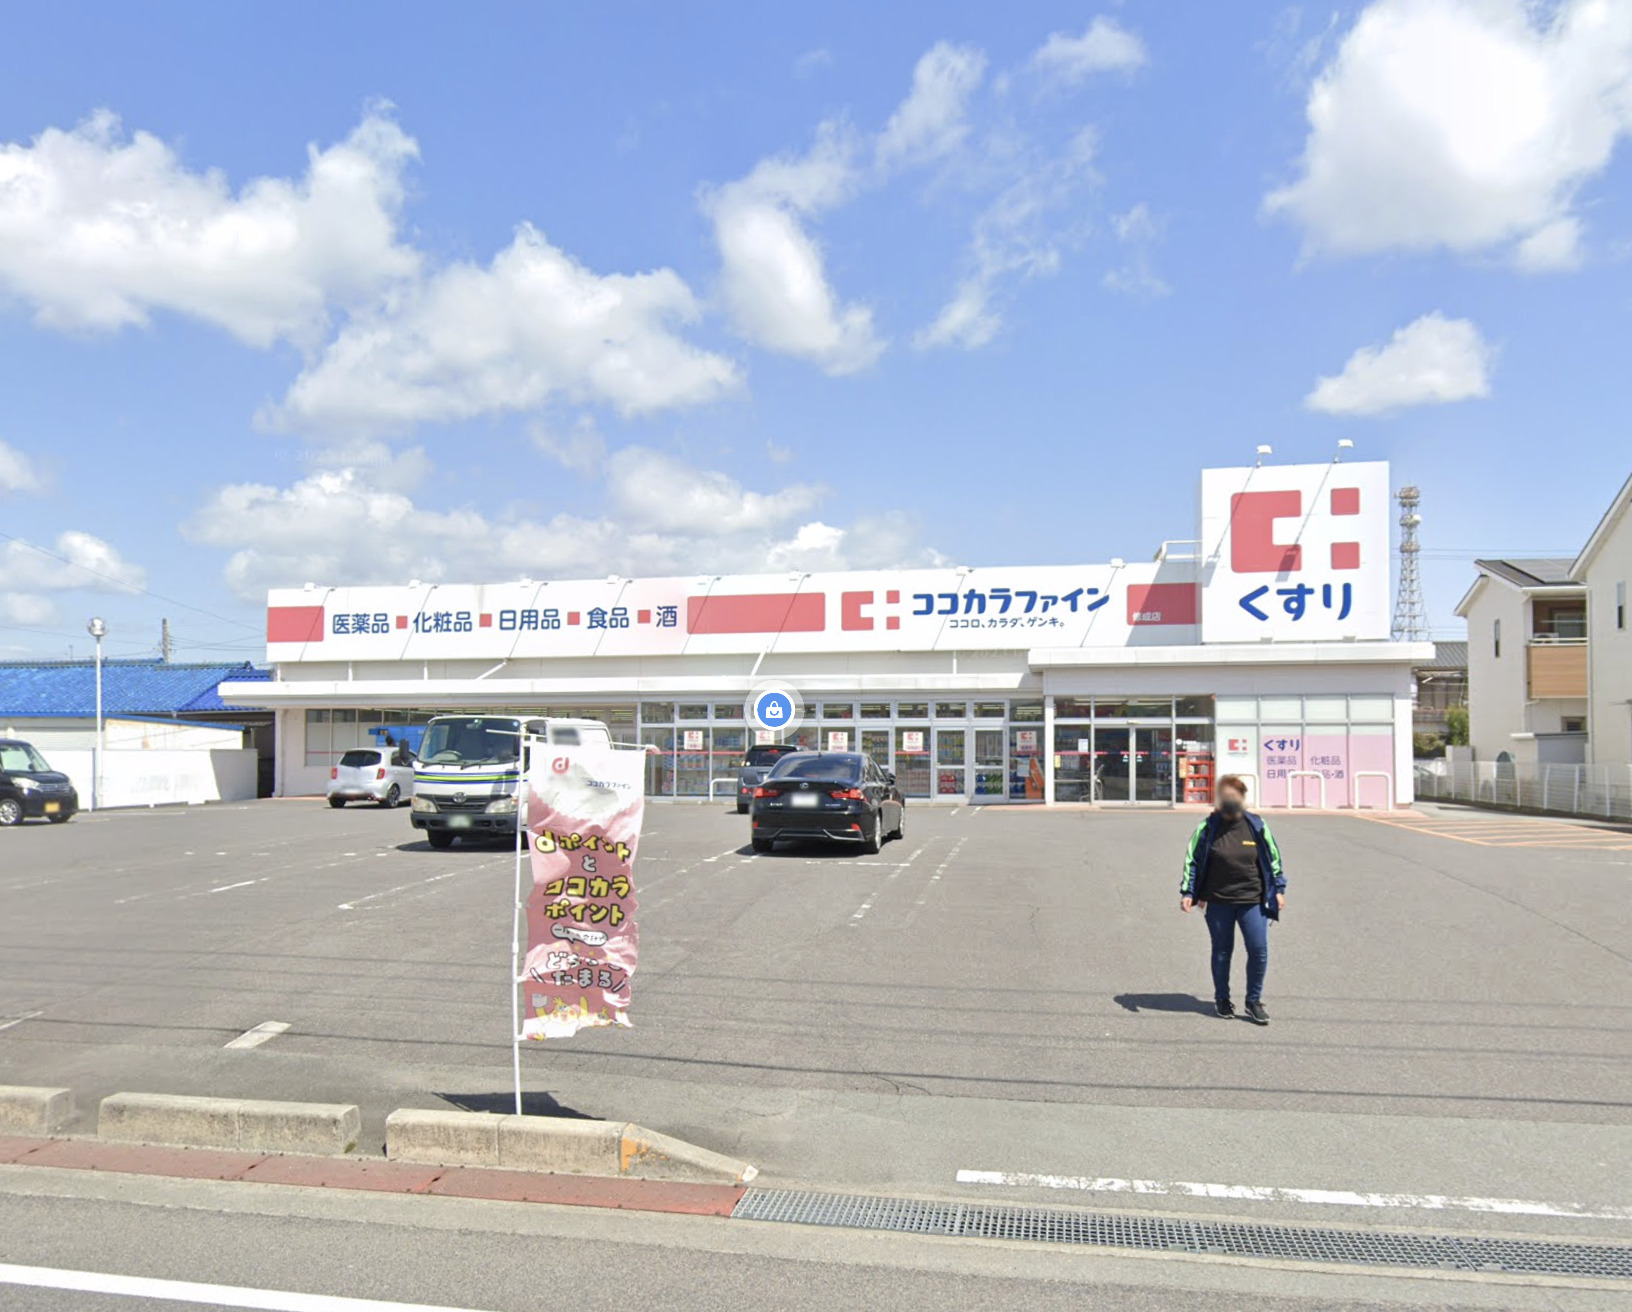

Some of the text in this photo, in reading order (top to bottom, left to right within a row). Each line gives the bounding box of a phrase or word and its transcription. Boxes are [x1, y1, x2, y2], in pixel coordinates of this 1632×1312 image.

[912, 588, 1109, 615] ココカラファイン
[1239, 583, 1351, 621] くすり
[332, 605, 678, 634] 医薬品 化粧品 日用品 食品 酒
[950, 617, 1065, 628] ココロ、カラダ、ゲンキ。
[1264, 739, 1300, 751] くすり
[1267, 755, 1342, 766] 医薬品 化粧品
[582, 854, 597, 872] と
[544, 875, 630, 899] ココカラ
[544, 898, 625, 926] ポイント
